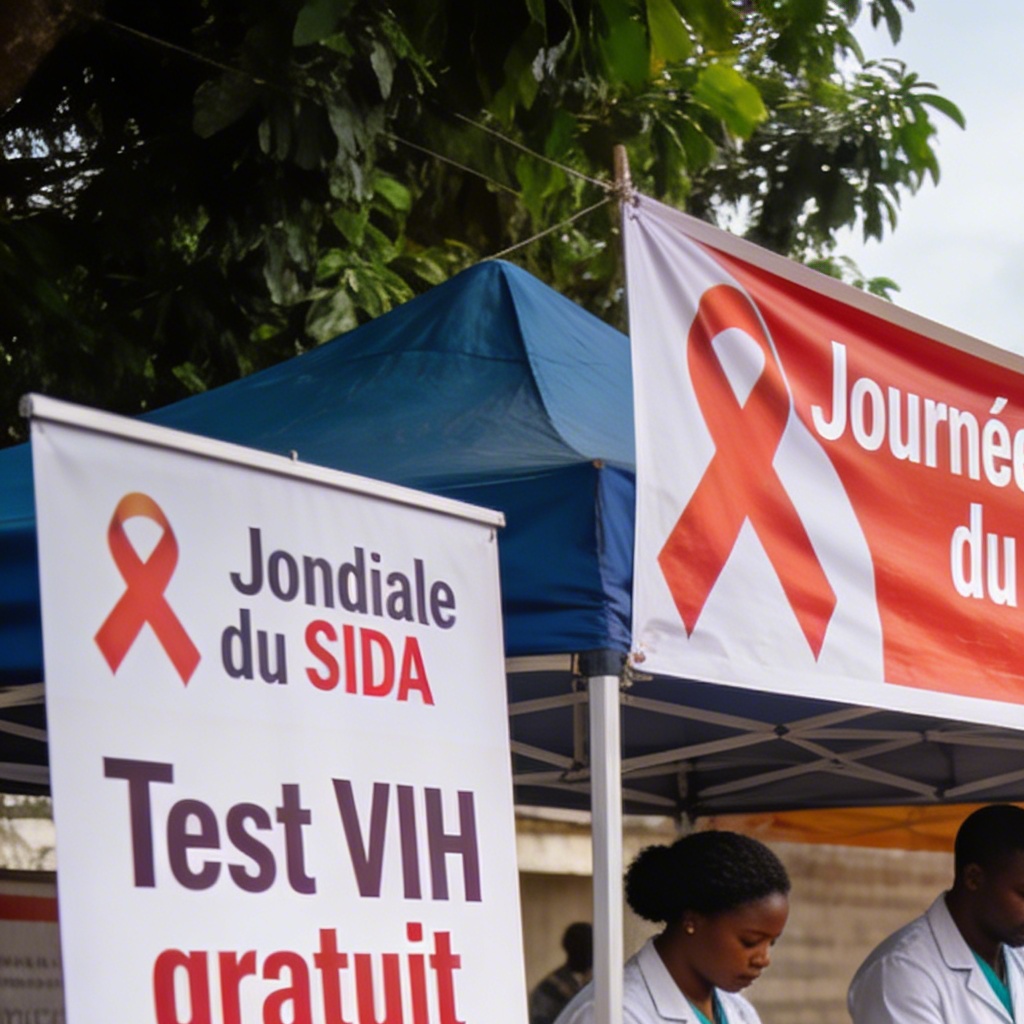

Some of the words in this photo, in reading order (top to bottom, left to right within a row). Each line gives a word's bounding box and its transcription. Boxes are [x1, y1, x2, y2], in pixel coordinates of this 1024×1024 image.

[230, 527, 455, 628] Jondiale
[951, 504, 1015, 606] du
[221, 609, 286, 683] du
[304, 619, 434, 705] SIDA
[103, 757, 315, 894] Test
[332, 778, 481, 901] VIH
